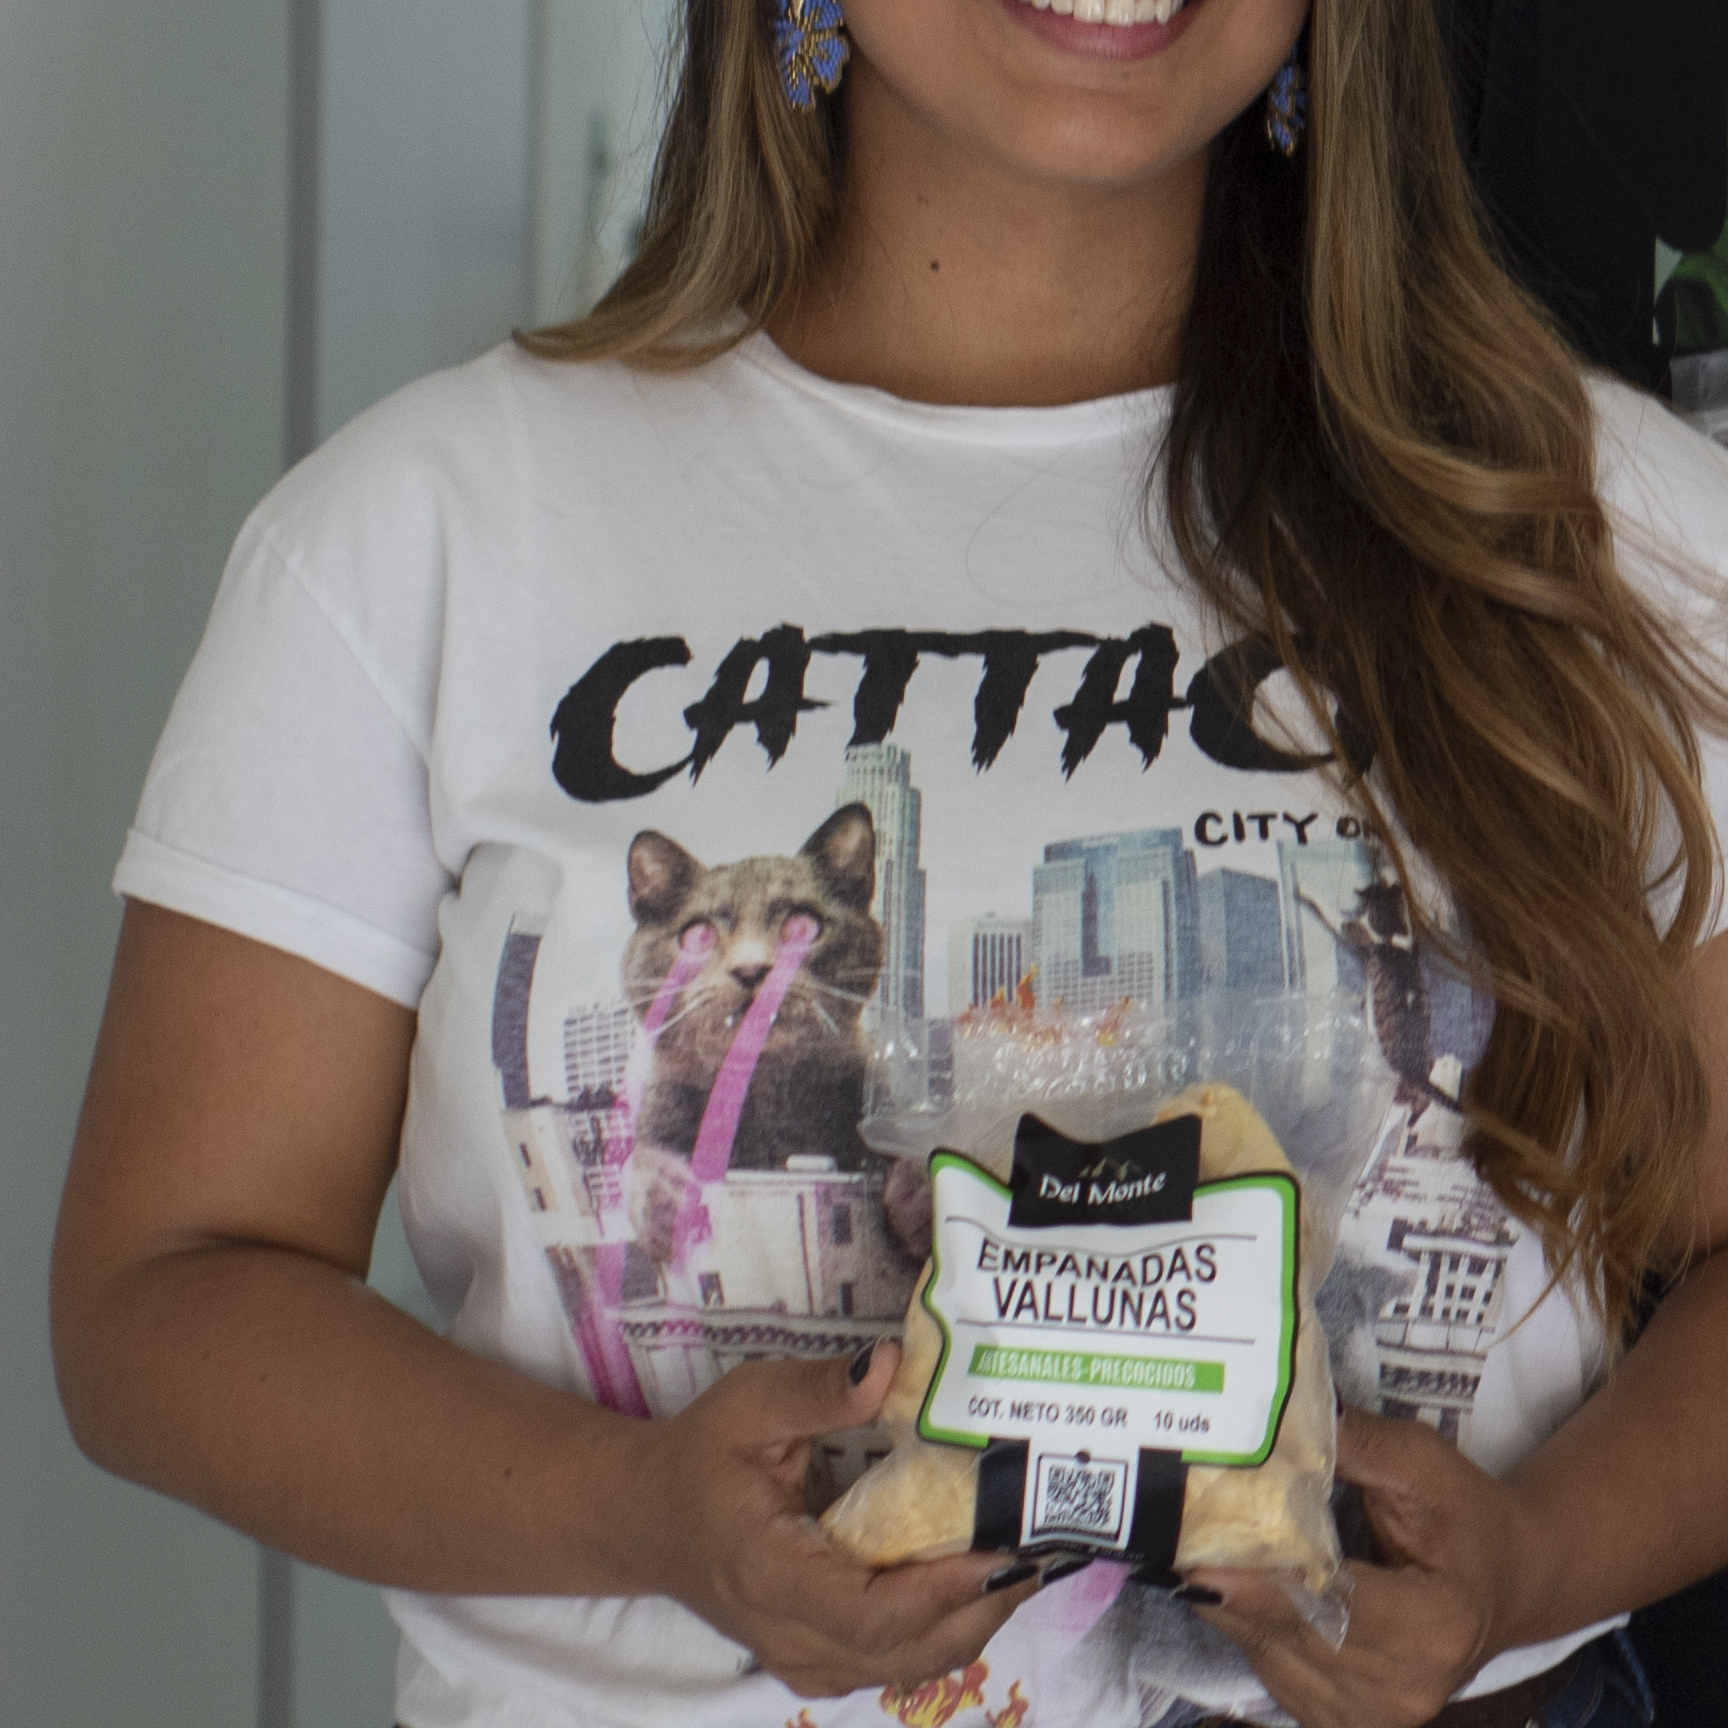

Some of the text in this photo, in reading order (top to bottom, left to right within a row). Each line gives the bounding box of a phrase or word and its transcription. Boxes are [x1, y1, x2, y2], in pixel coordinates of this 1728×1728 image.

[549, 621, 1378, 803] CATTAC
[1194, 810, 1318, 846] CITY
[1038, 1172, 1167, 1206] Del Monte
[977, 1237, 1217, 1288] EMPANADAS
[993, 1277, 1198, 1333] VALLUNAS
[1009, 1399, 1060, 1422] NETO
[1066, 1405, 1095, 1424] 350
[1101, 1407, 1129, 1428] GR
[1154, 1410, 1174, 1430] 10
[1179, 1413, 1211, 1434] uds
